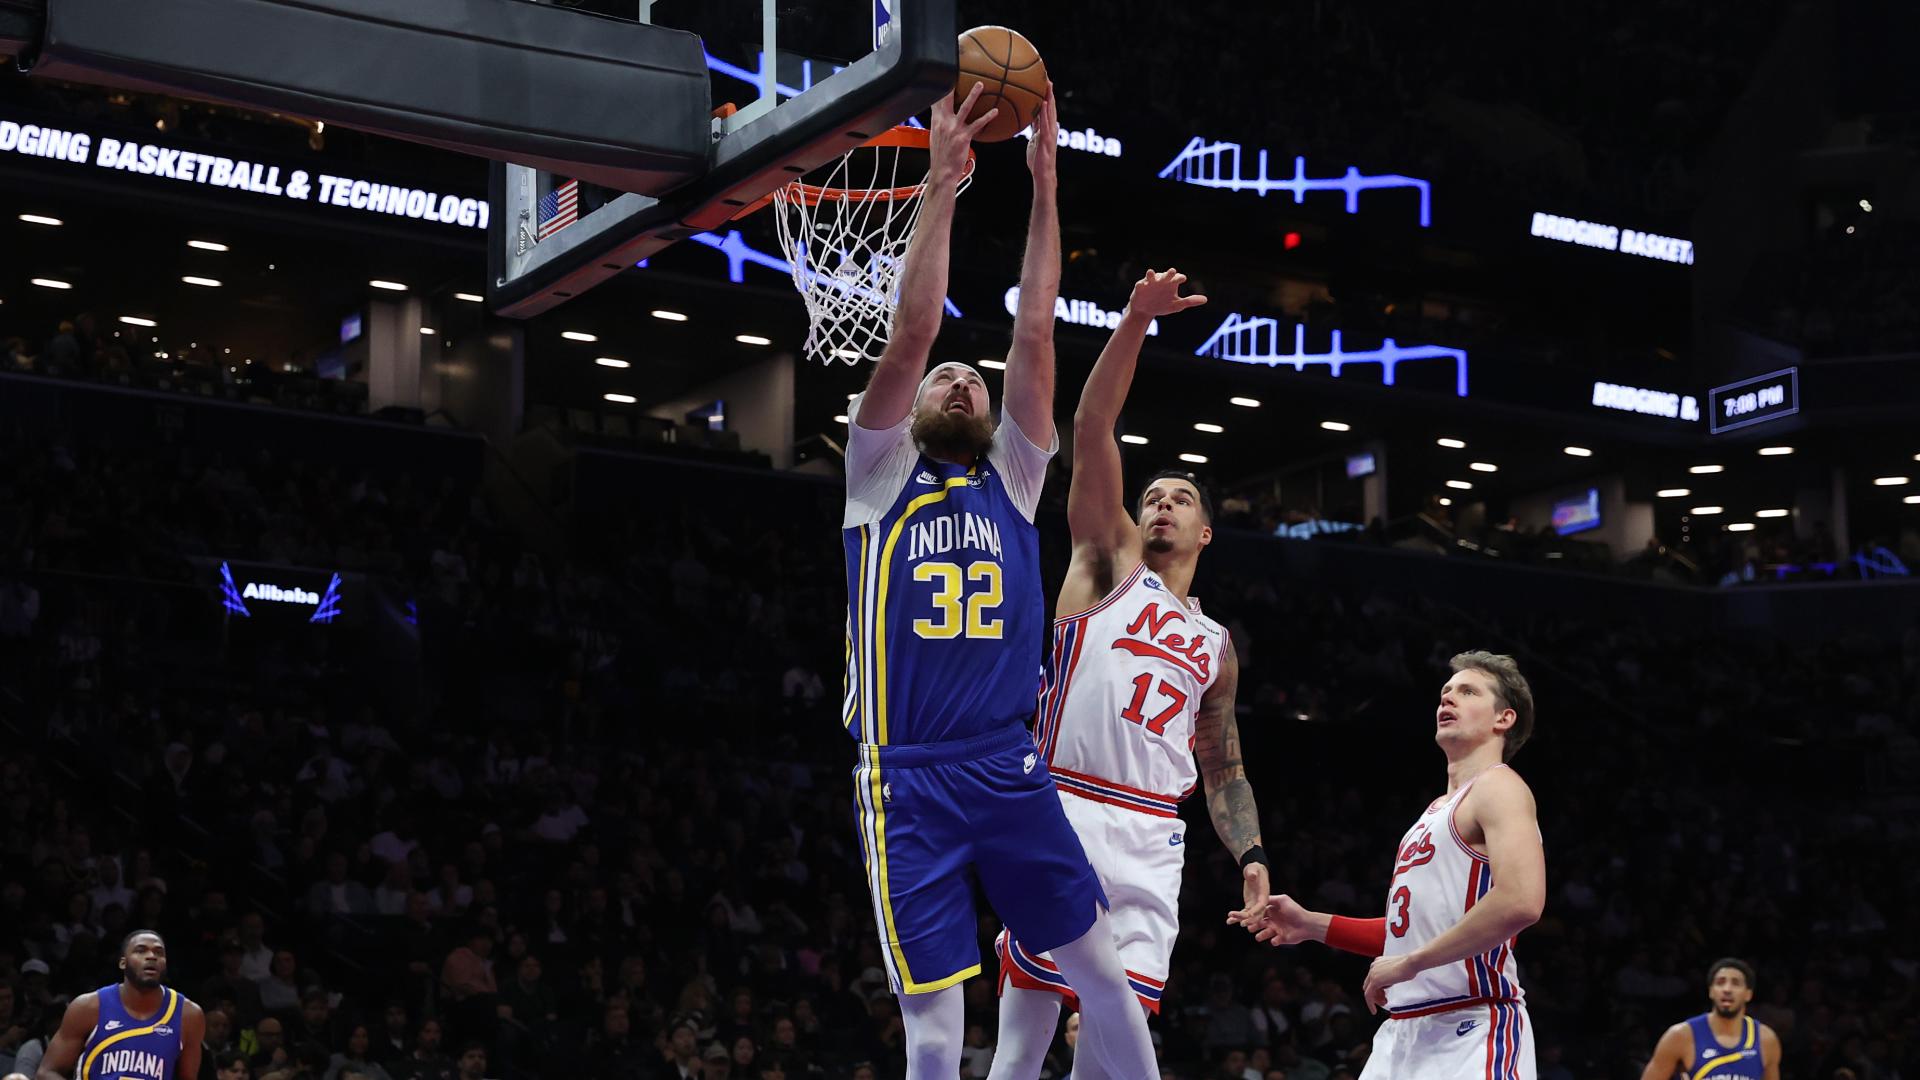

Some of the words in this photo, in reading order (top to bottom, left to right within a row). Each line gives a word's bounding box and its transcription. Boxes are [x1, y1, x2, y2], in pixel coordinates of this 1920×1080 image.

[96, 137, 283, 196] BASKETBALL
[286, 170, 311, 200] &
[1531, 212, 1619, 251] BRIDGING
[1592, 382, 1679, 418] BRIDGING
[1758, 384, 1784, 408] PM
[919, 470, 939, 482] NIKE
[907, 511, 1004, 562] INDIANA
[242, 582, 320, 605] Alibaba
[912, 560, 1004, 639] 32
[1112, 602, 1211, 686] Nets
[1120, 671, 1188, 737] 17
[101, 1049, 165, 1080] INDIANA
